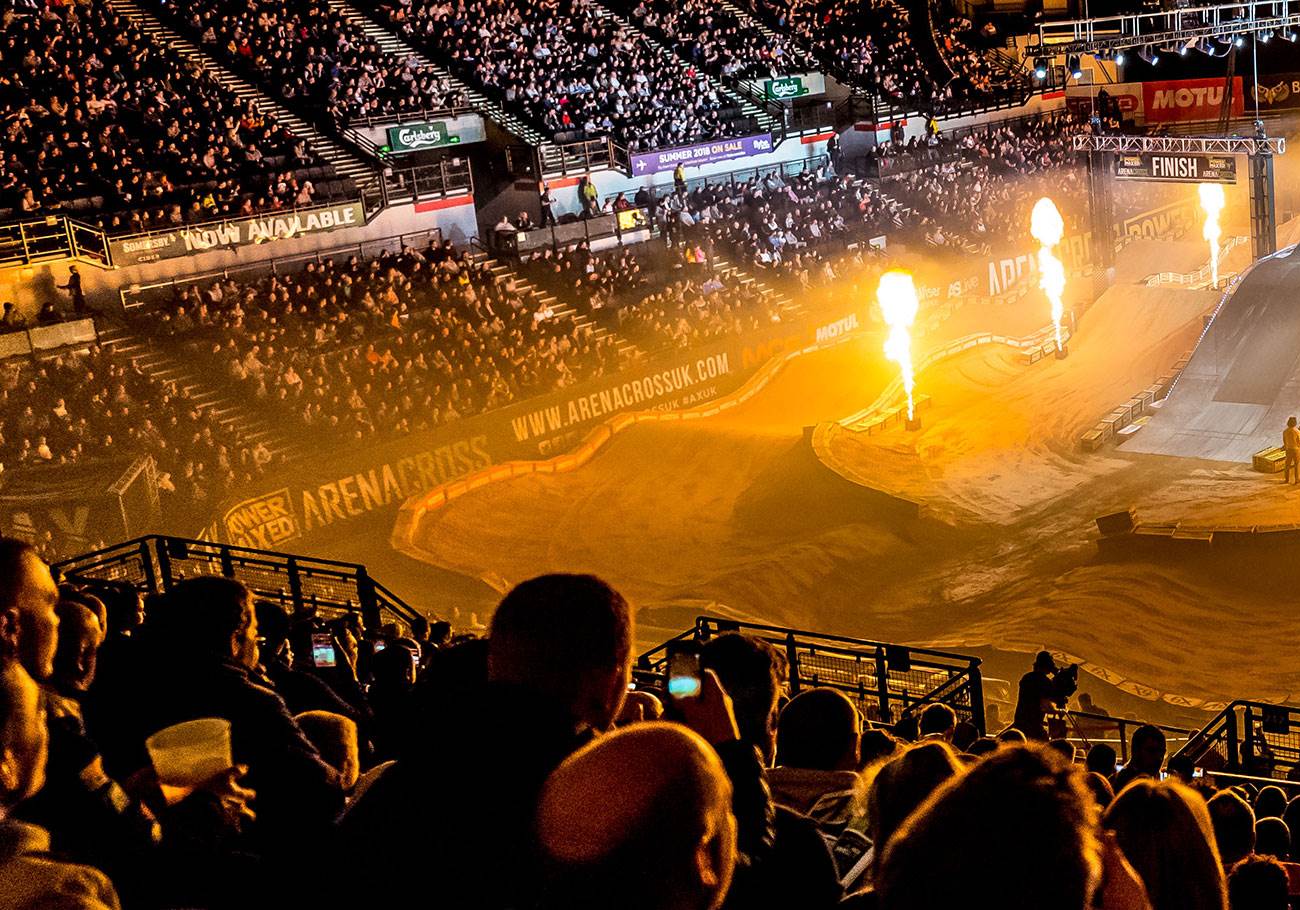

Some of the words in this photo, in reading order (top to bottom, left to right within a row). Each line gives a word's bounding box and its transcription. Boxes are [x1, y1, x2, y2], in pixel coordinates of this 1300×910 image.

[772, 81, 798, 97] Carlsberg
[1152, 86, 1236, 109] MOTU
[399, 126, 441, 147] Carlsberg
[659, 150, 692, 163] SUMMER
[693, 147, 710, 158] 2018
[712, 144, 723, 153] ON
[725, 141, 742, 151] SALE
[1152, 157, 1198, 177] FINISH
[184, 226, 241, 251] NOW
[248, 206, 356, 240] AVAILABLE
[816, 314, 859, 341] MOTUL
[511, 353, 729, 442] WWW.ARENACROSSUK.COM
